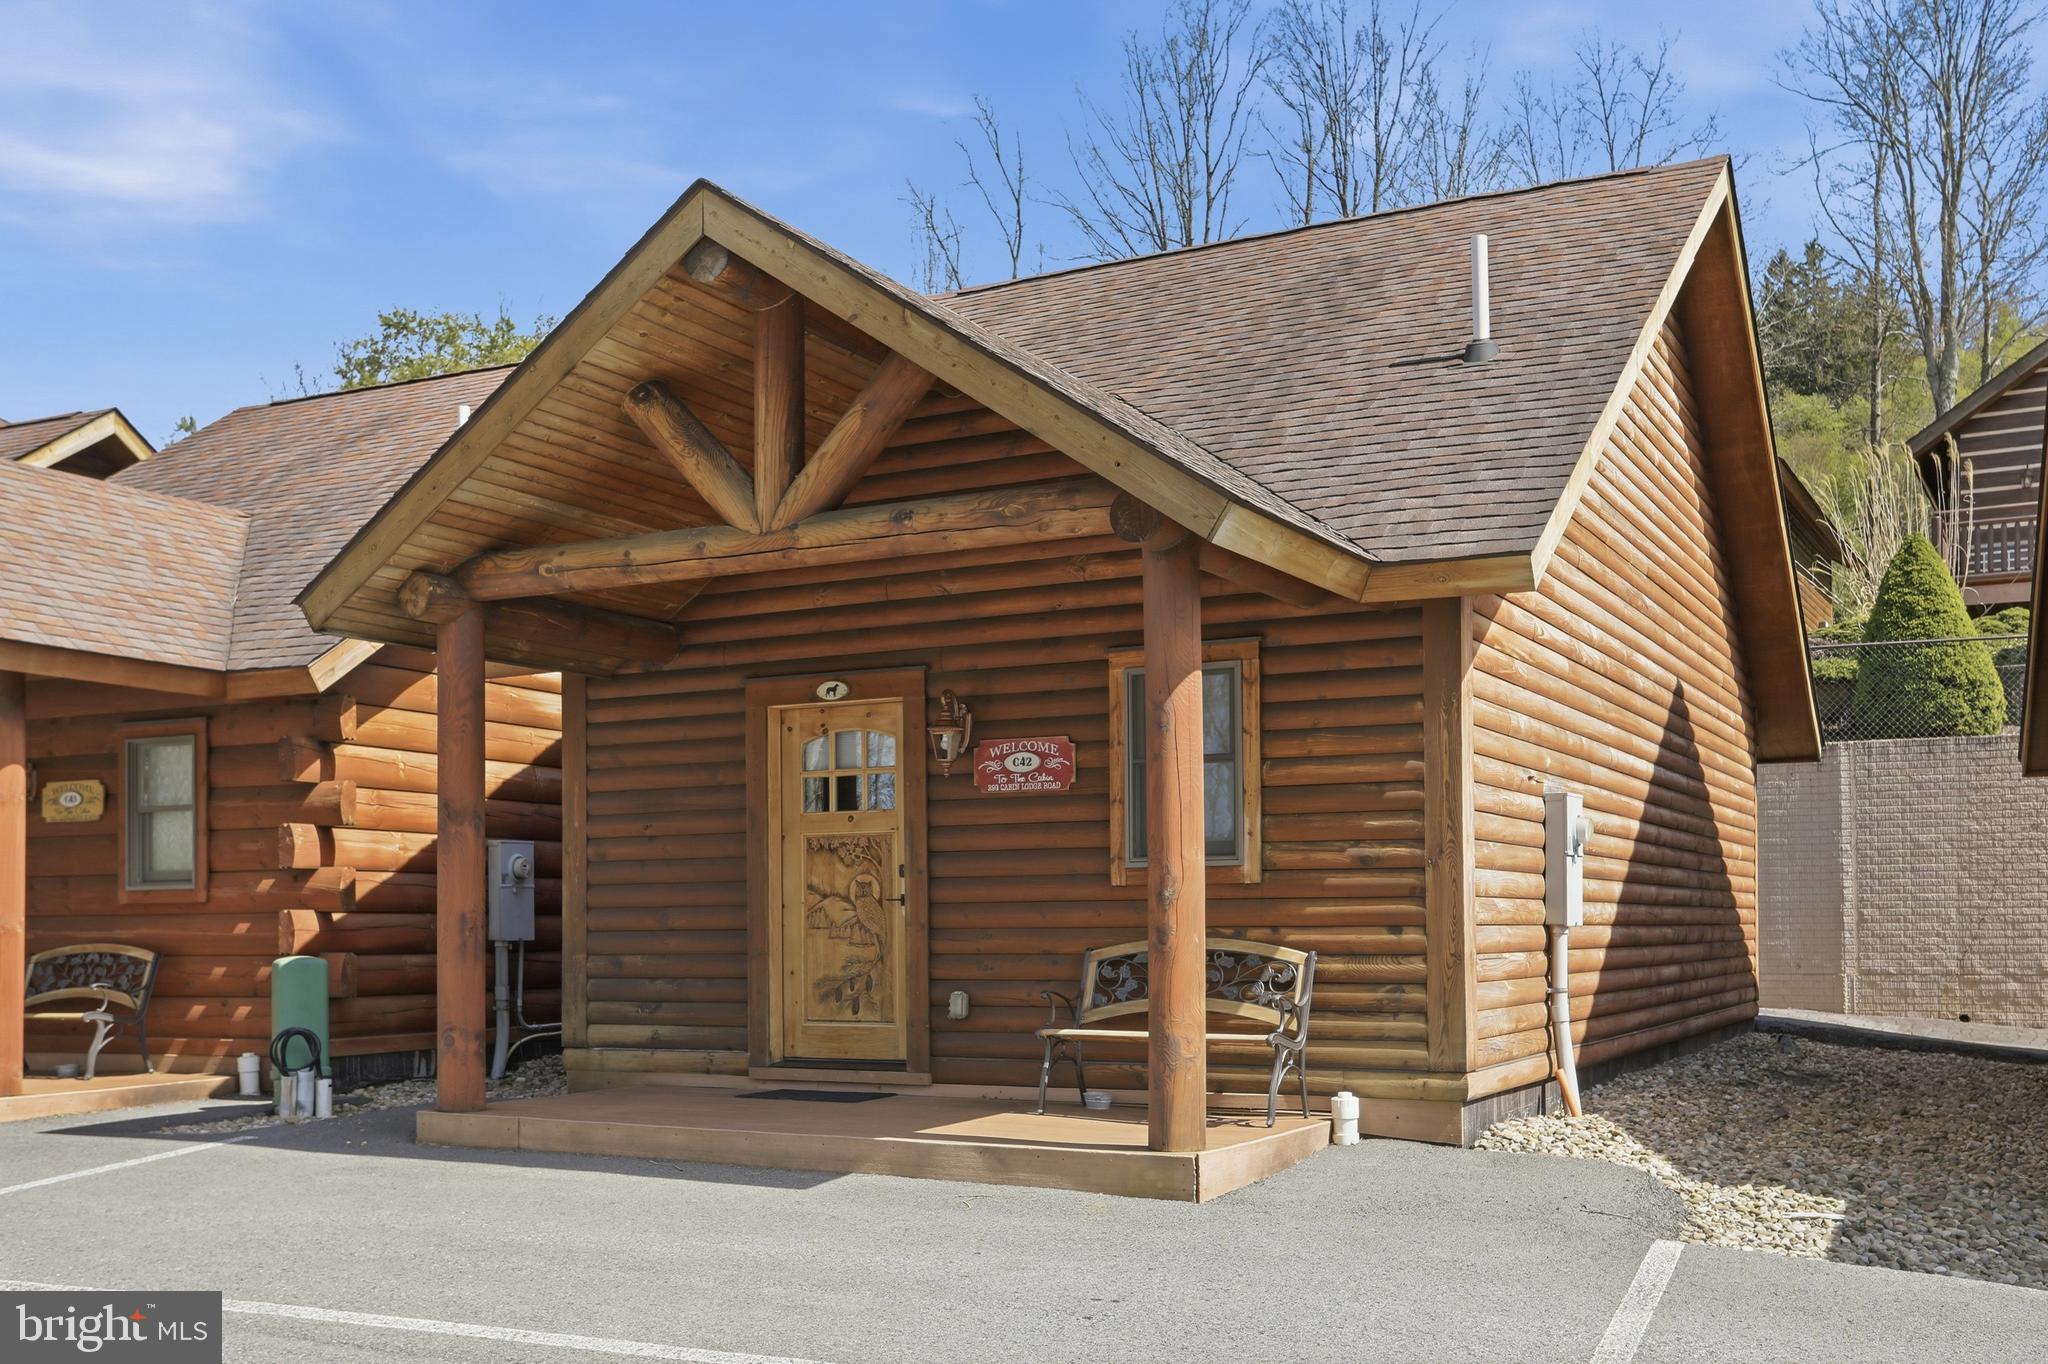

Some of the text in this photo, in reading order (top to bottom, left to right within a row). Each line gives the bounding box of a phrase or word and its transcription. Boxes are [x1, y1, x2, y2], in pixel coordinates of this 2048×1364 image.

[989, 741, 1060, 758] WELCOME
[1012, 757, 1032, 767] C42
[994, 772, 1054, 784] To The Cabin
[1021, 782, 1042, 790] LODGE
[1043, 781, 1061, 789] ROAD
